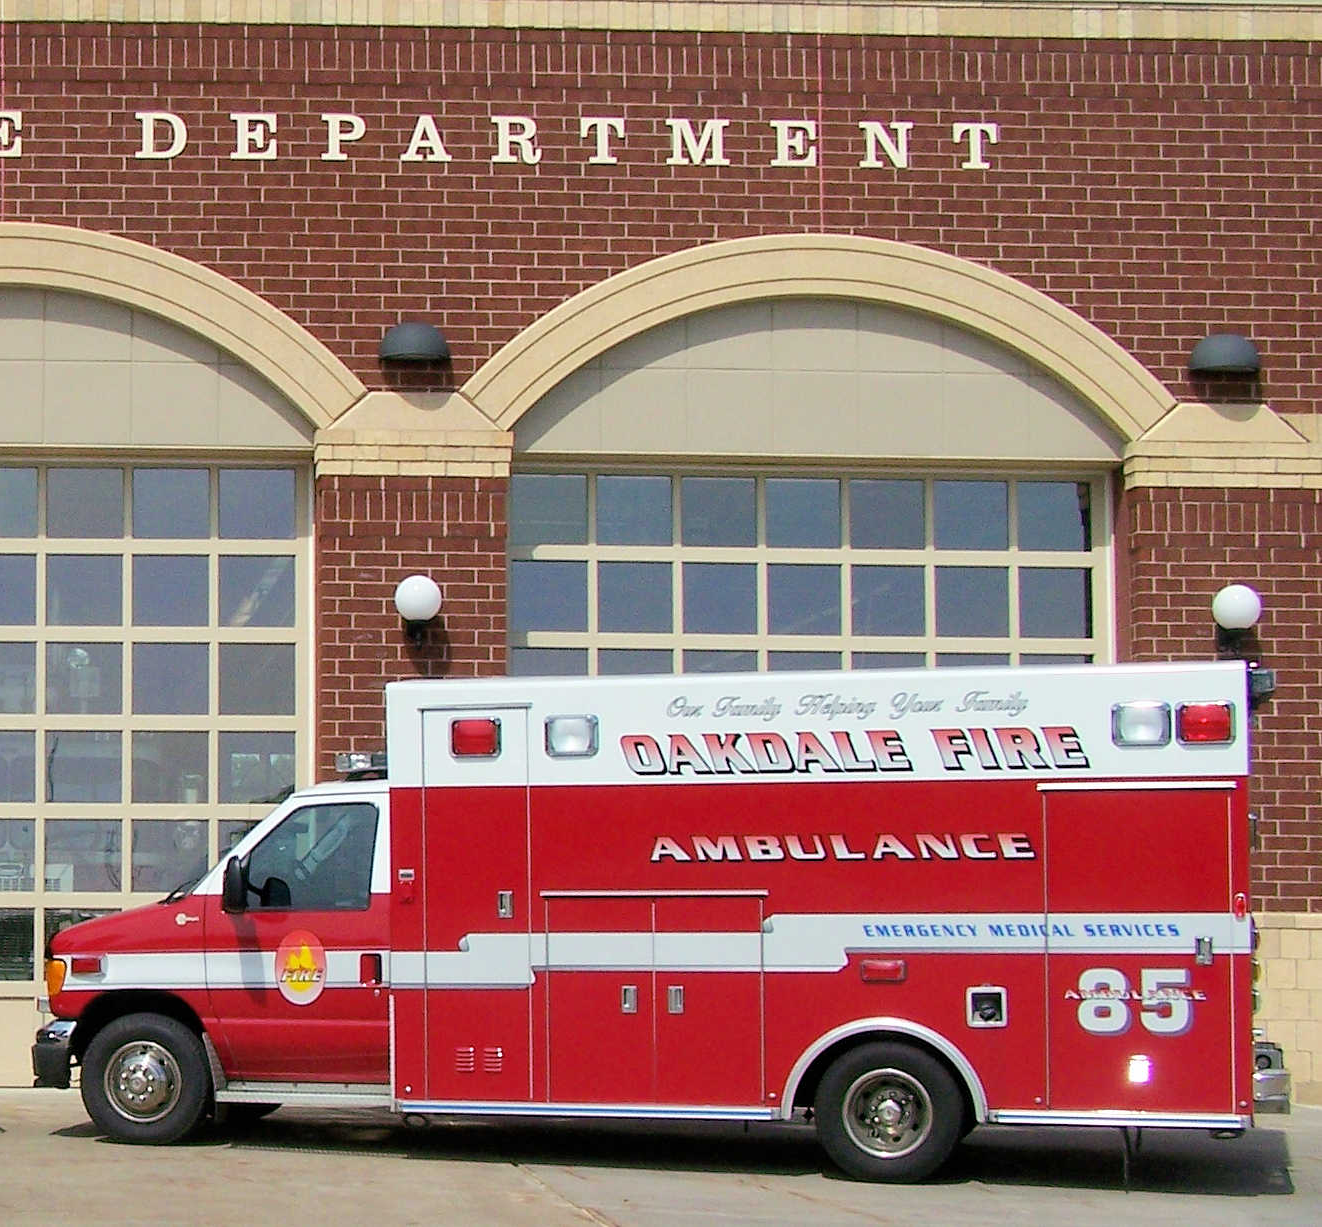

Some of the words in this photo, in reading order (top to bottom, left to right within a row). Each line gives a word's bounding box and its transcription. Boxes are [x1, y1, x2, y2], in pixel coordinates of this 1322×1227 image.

[134, 112, 1002, 170] DEPARTMENT
[666, 695, 704, 718] Our
[712, 695, 783, 722] Family
[794, 692, 877, 721] Helping
[888, 691, 944, 720] Your
[955, 690, 1029, 718] Family
[620, 727, 914, 776] OAKDALE
[929, 724, 1092, 770] FIRE
[649, 831, 1036, 864] AMBULANCE
[863, 924, 979, 939] EMERGENCY
[988, 924, 1076, 939] MEDICAL
[1084, 923, 1181, 938] SERVICES
[279, 967, 324, 983] FIRE
[1064, 988, 1208, 1001] AMBULANCE
[1077, 967, 1194, 1037] 85
